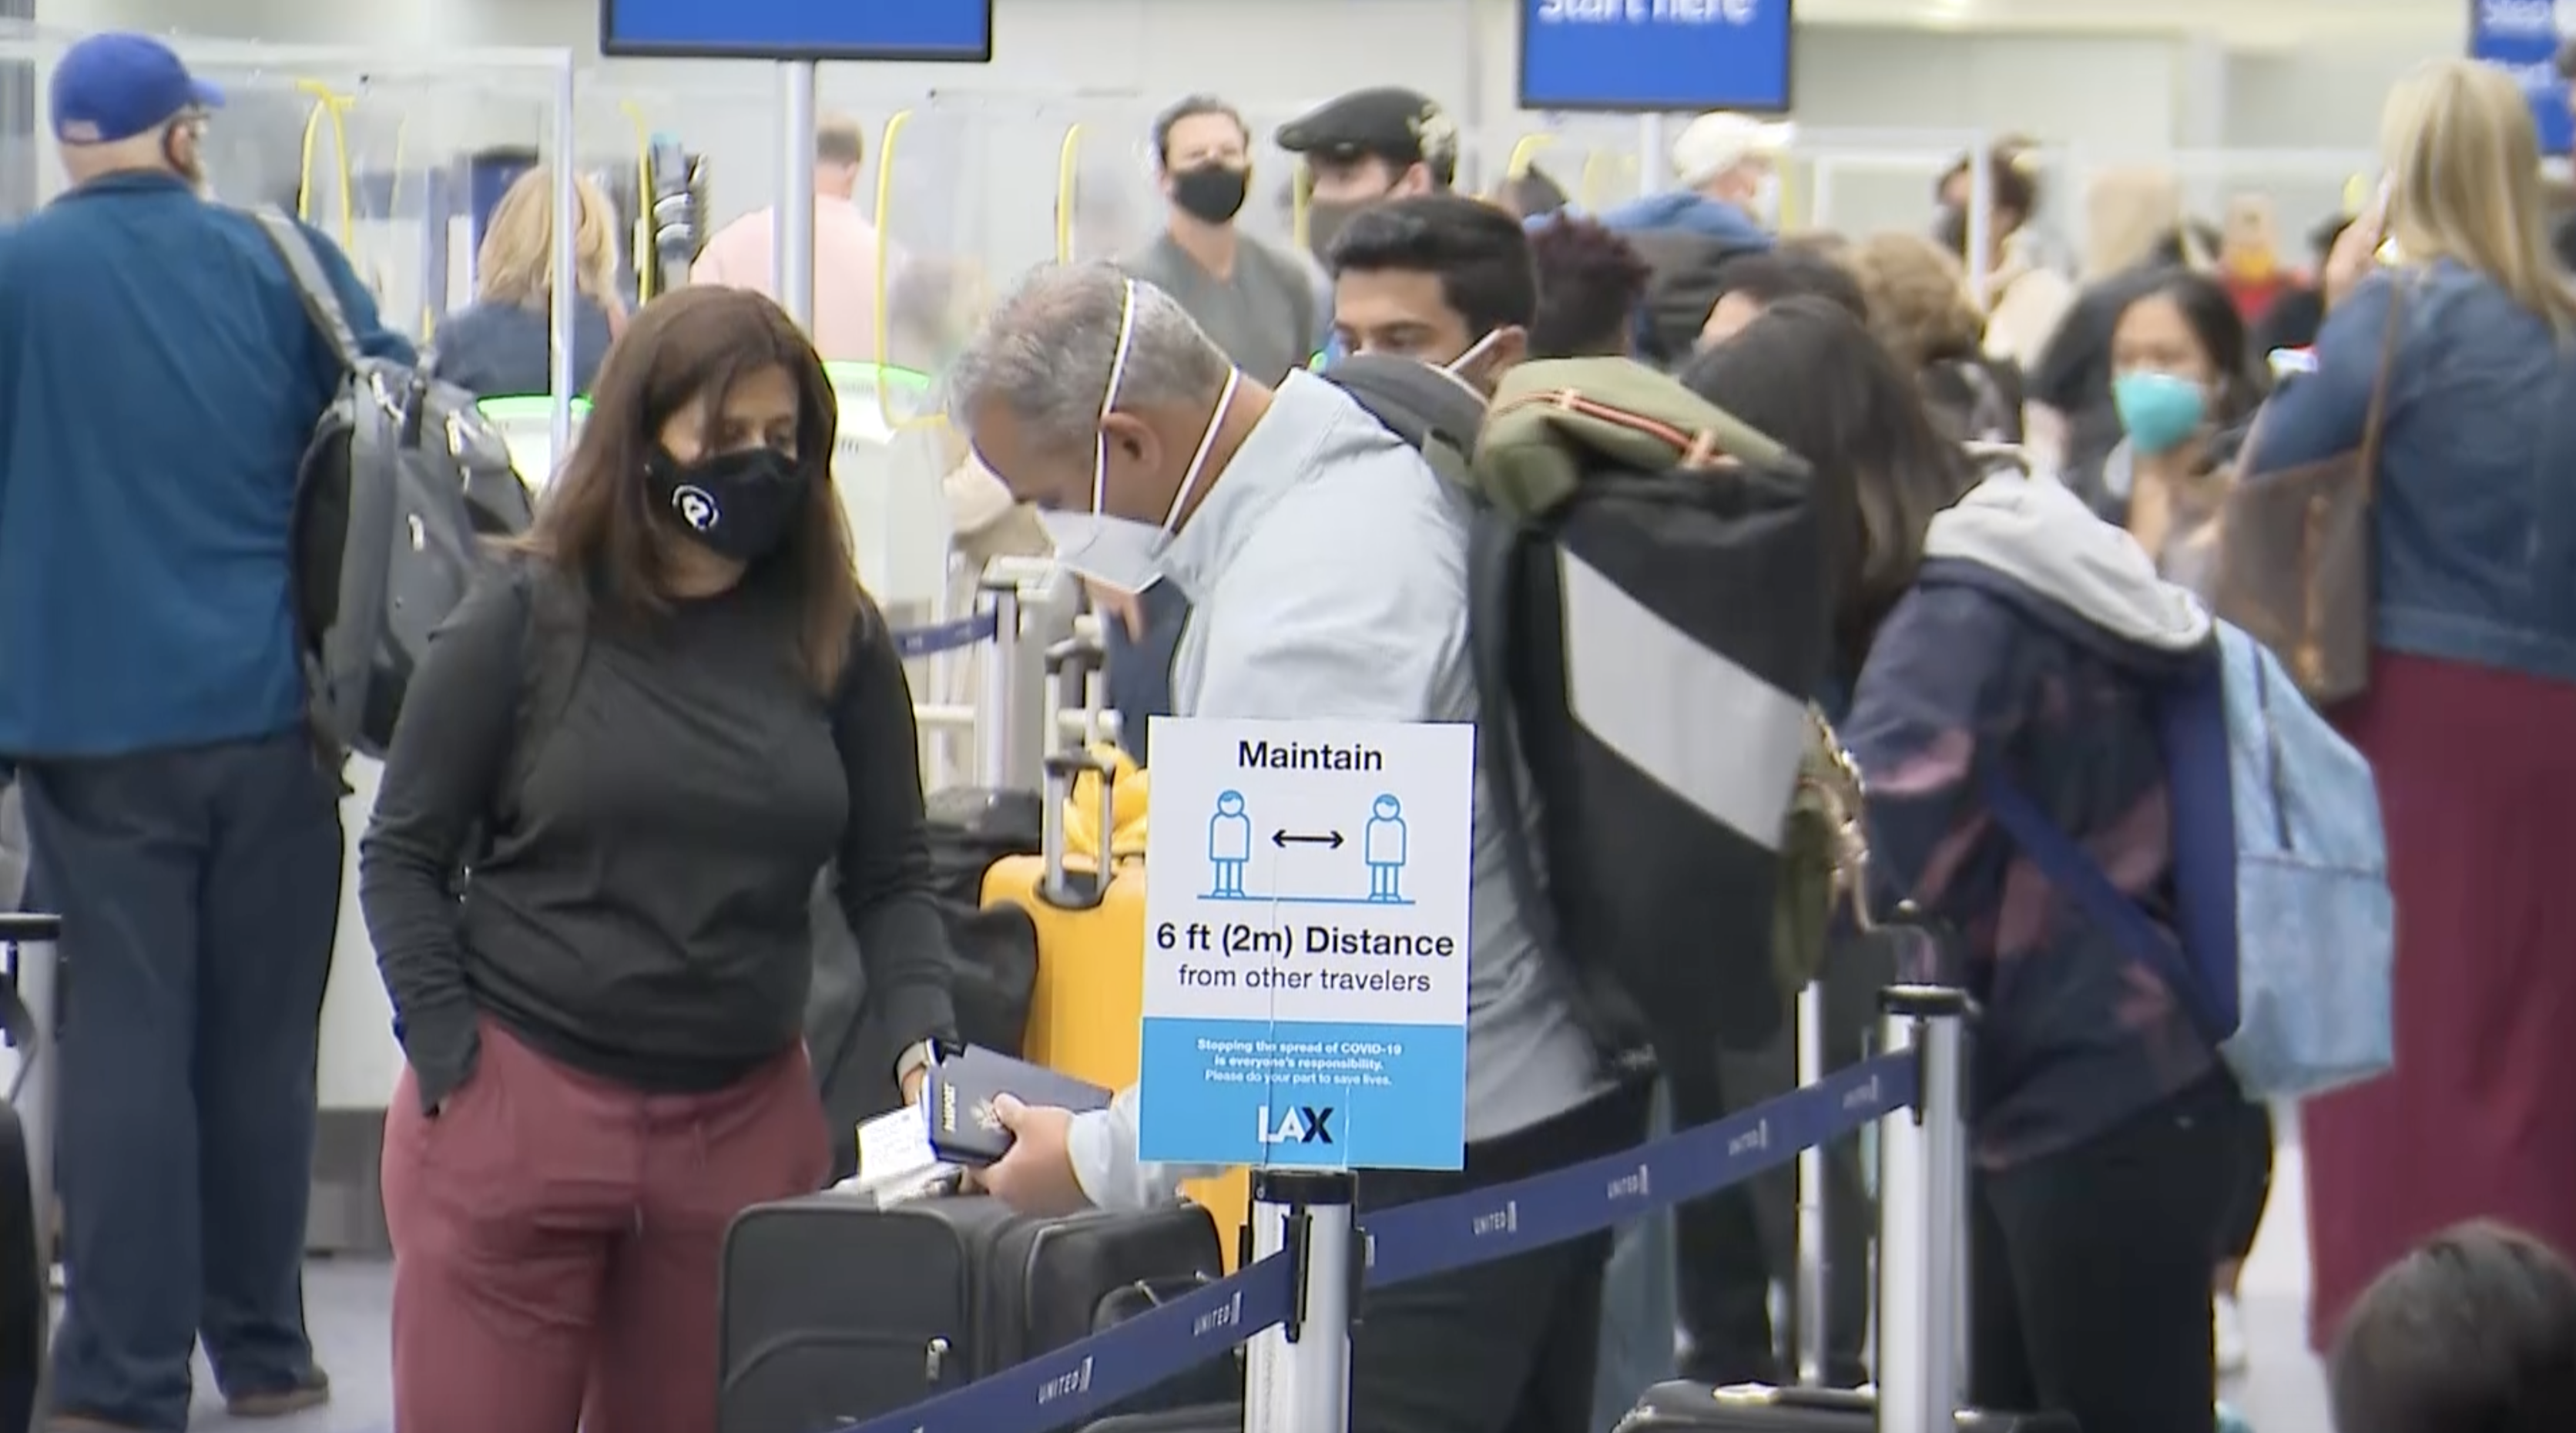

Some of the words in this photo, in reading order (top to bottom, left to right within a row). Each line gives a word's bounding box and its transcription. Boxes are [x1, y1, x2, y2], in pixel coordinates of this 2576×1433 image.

[1538, 0, 1647, 24] Start
[1238, 740, 1383, 771] Maintain
[1156, 922, 1176, 950] 6
[1186, 923, 1211, 950] ft
[1223, 925, 1293, 958] (2m)
[1306, 927, 1455, 956] Distance
[1179, 964, 1236, 987] from
[1245, 965, 1313, 988] other
[1320, 968, 1431, 992] travelers
[1197, 1039, 1253, 1053] Stopping
[1256, 1040, 1275, 1052] the
[1280, 1041, 1322, 1055] spread
[1325, 1042, 1338, 1052] of
[1340, 1043, 1403, 1055] COVID-19
[1214, 1055, 1226, 1066] is
[1228, 1056, 1295, 1070] everyone's
[1298, 1057, 1384, 1071] responsibility.
[1205, 1069, 1243, 1082] Please
[1246, 1070, 1262, 1082] do
[1265, 1073, 1290, 1085] your
[1293, 1072, 1317, 1087] part
[1319, 1073, 1331, 1083] to
[1334, 1075, 1361, 1085] save
[1363, 1073, 1392, 1086] lives.
[1257, 1105, 1334, 1145] LAX
[1608, 1175, 1638, 1200] UNITED
[1472, 1211, 1507, 1236] UNITED
[1193, 1304, 1230, 1337] UNITED
[1038, 1370, 1079, 1404] UNITED
